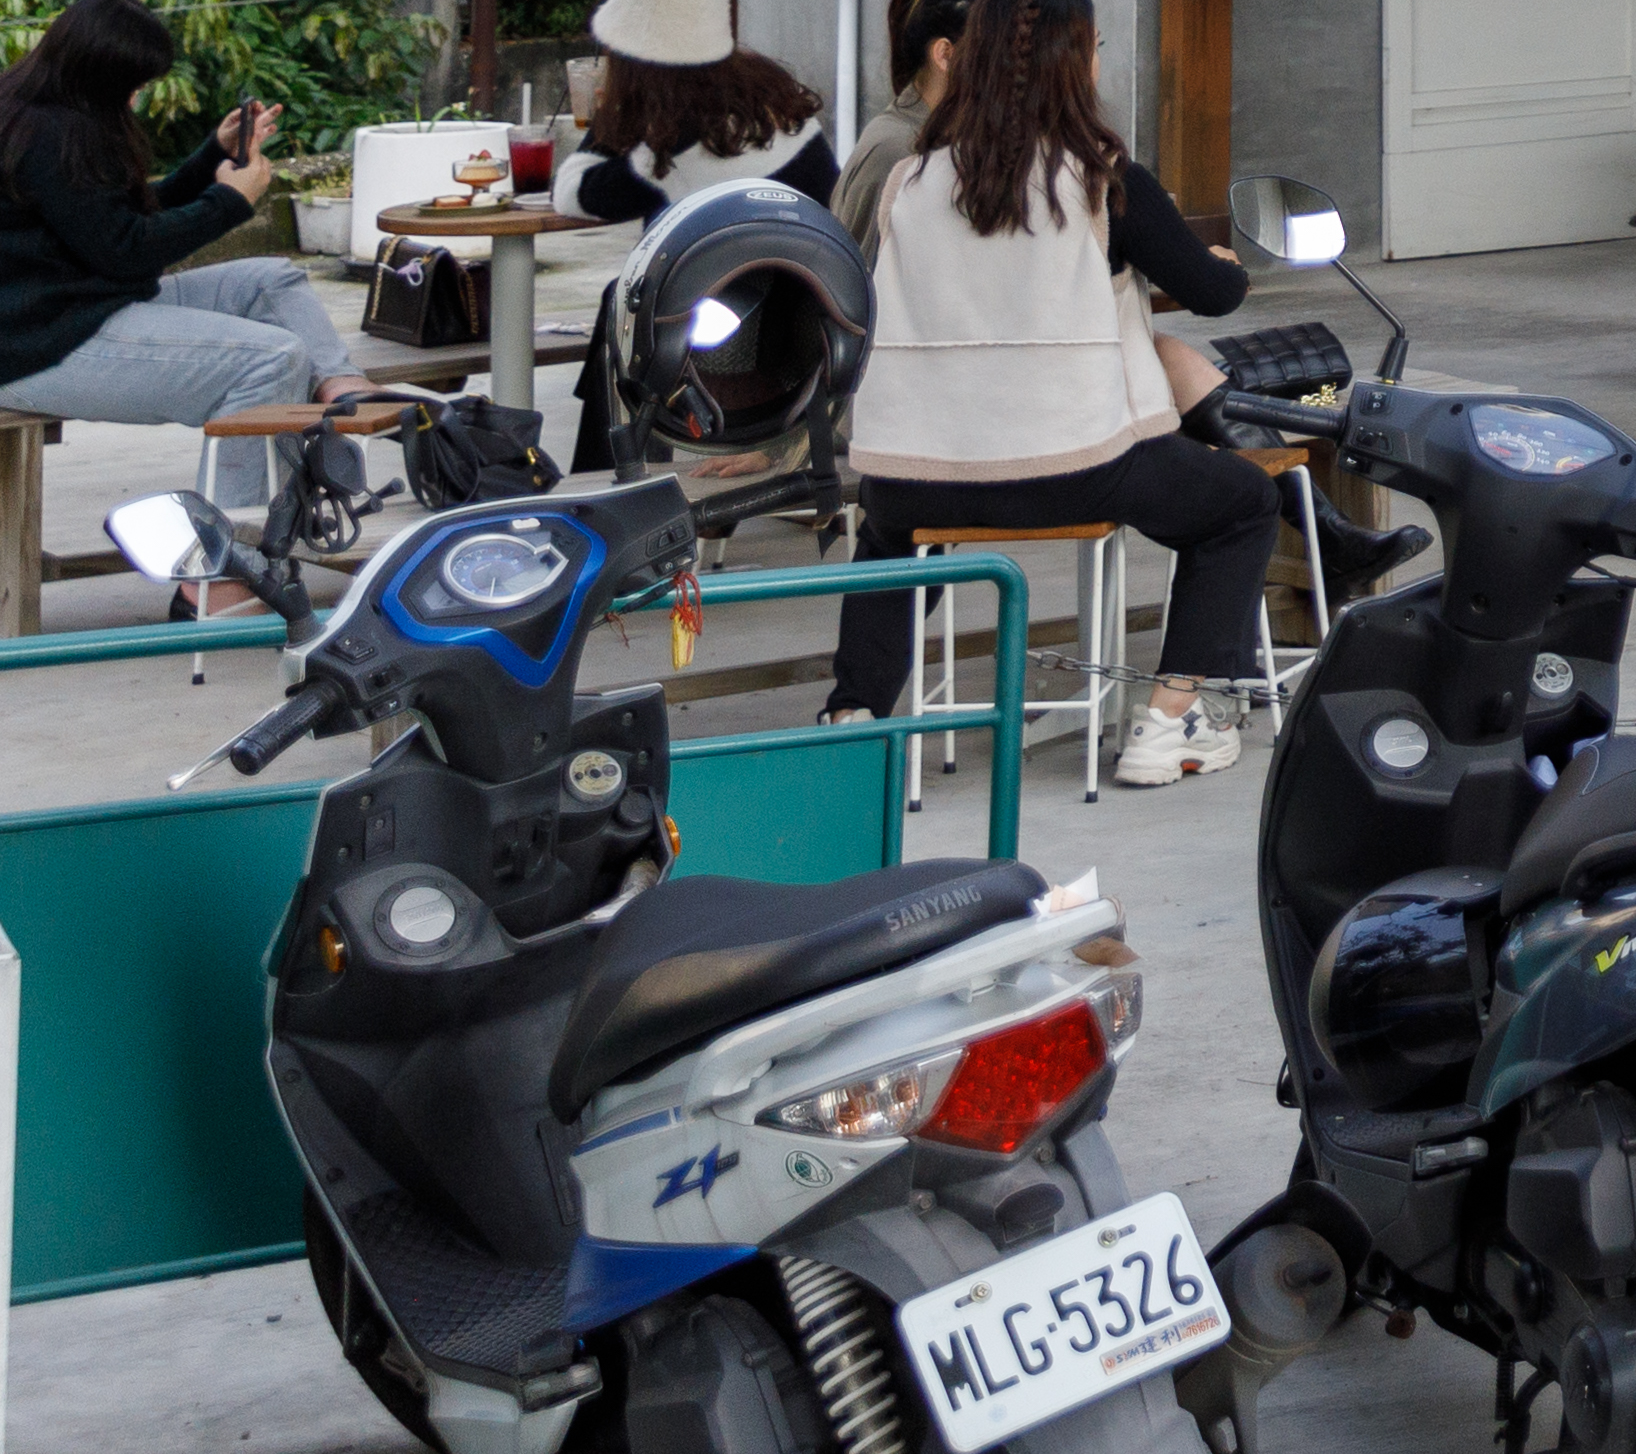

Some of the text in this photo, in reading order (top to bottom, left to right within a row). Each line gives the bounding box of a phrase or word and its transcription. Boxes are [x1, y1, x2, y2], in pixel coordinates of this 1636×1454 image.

[756, 190, 793, 201] ZEUS
[884, 884, 982, 933] SANYANG
[927, 1233, 1204, 1412] MLG-5326
